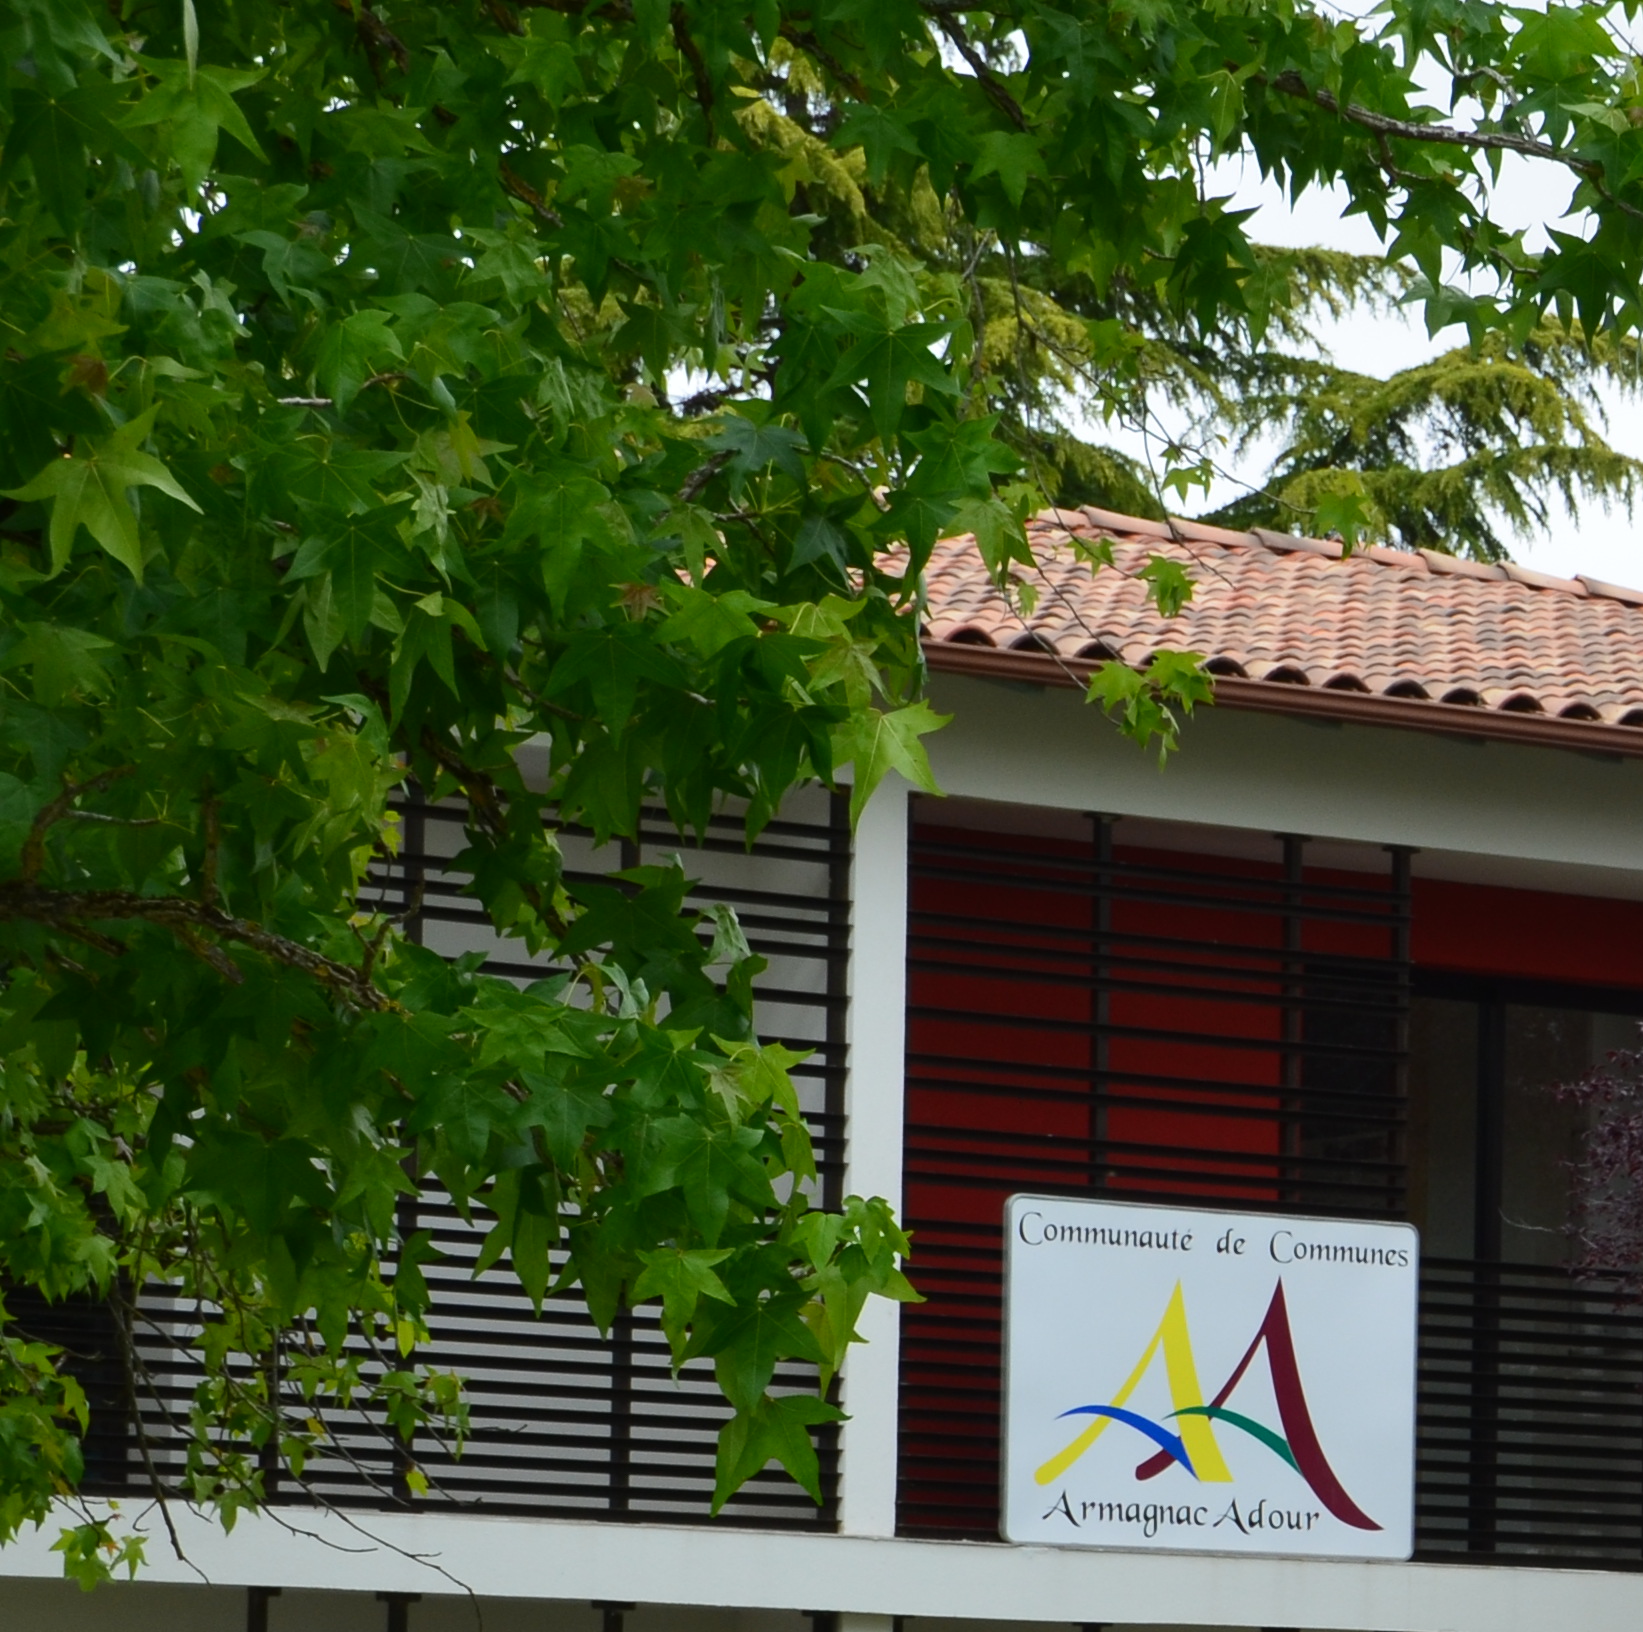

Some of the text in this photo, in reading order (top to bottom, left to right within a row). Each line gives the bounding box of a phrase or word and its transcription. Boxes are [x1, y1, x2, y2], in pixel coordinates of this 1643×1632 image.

[1215, 1228, 1246, 1256] de
[1269, 1230, 1409, 1268] Communes
[1041, 1489, 1320, 1538] Armagnac Adour
